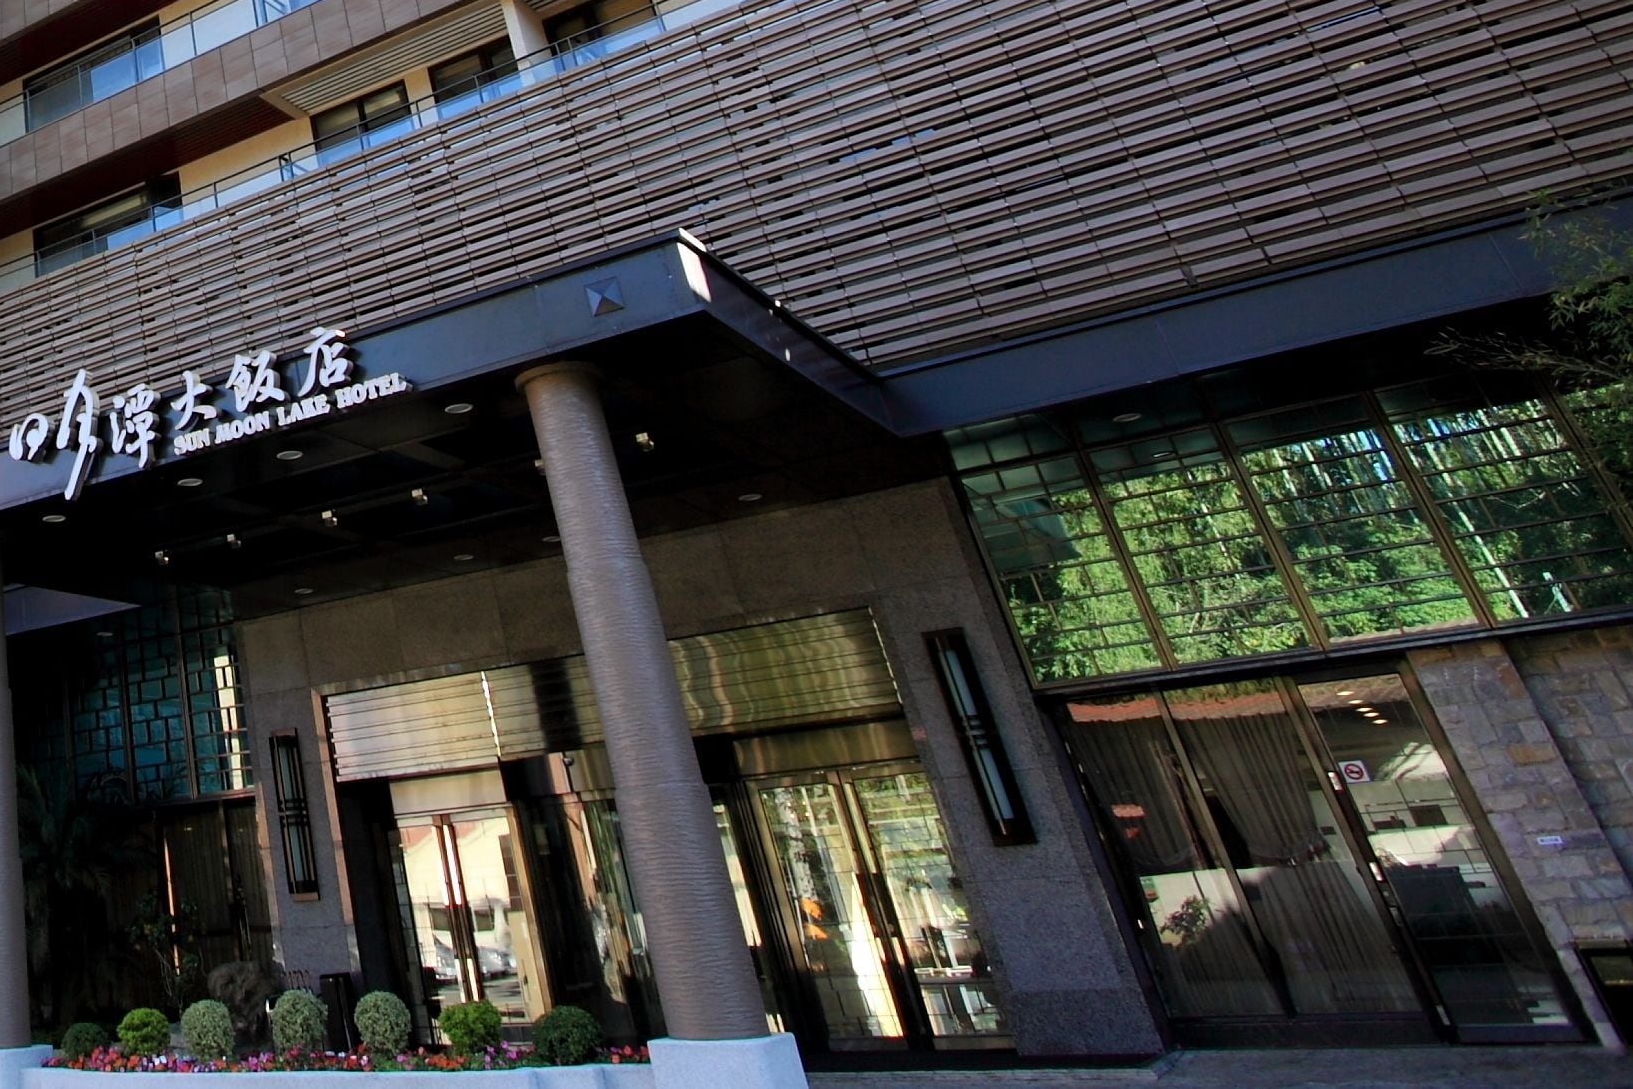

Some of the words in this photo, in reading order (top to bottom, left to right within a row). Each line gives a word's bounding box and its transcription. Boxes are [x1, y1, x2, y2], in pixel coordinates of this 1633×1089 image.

[173, 427, 212, 456] SUN
[214, 410, 271, 445] MOON
[276, 393, 332, 427] LAKE
[334, 372, 409, 409] HOTEL
